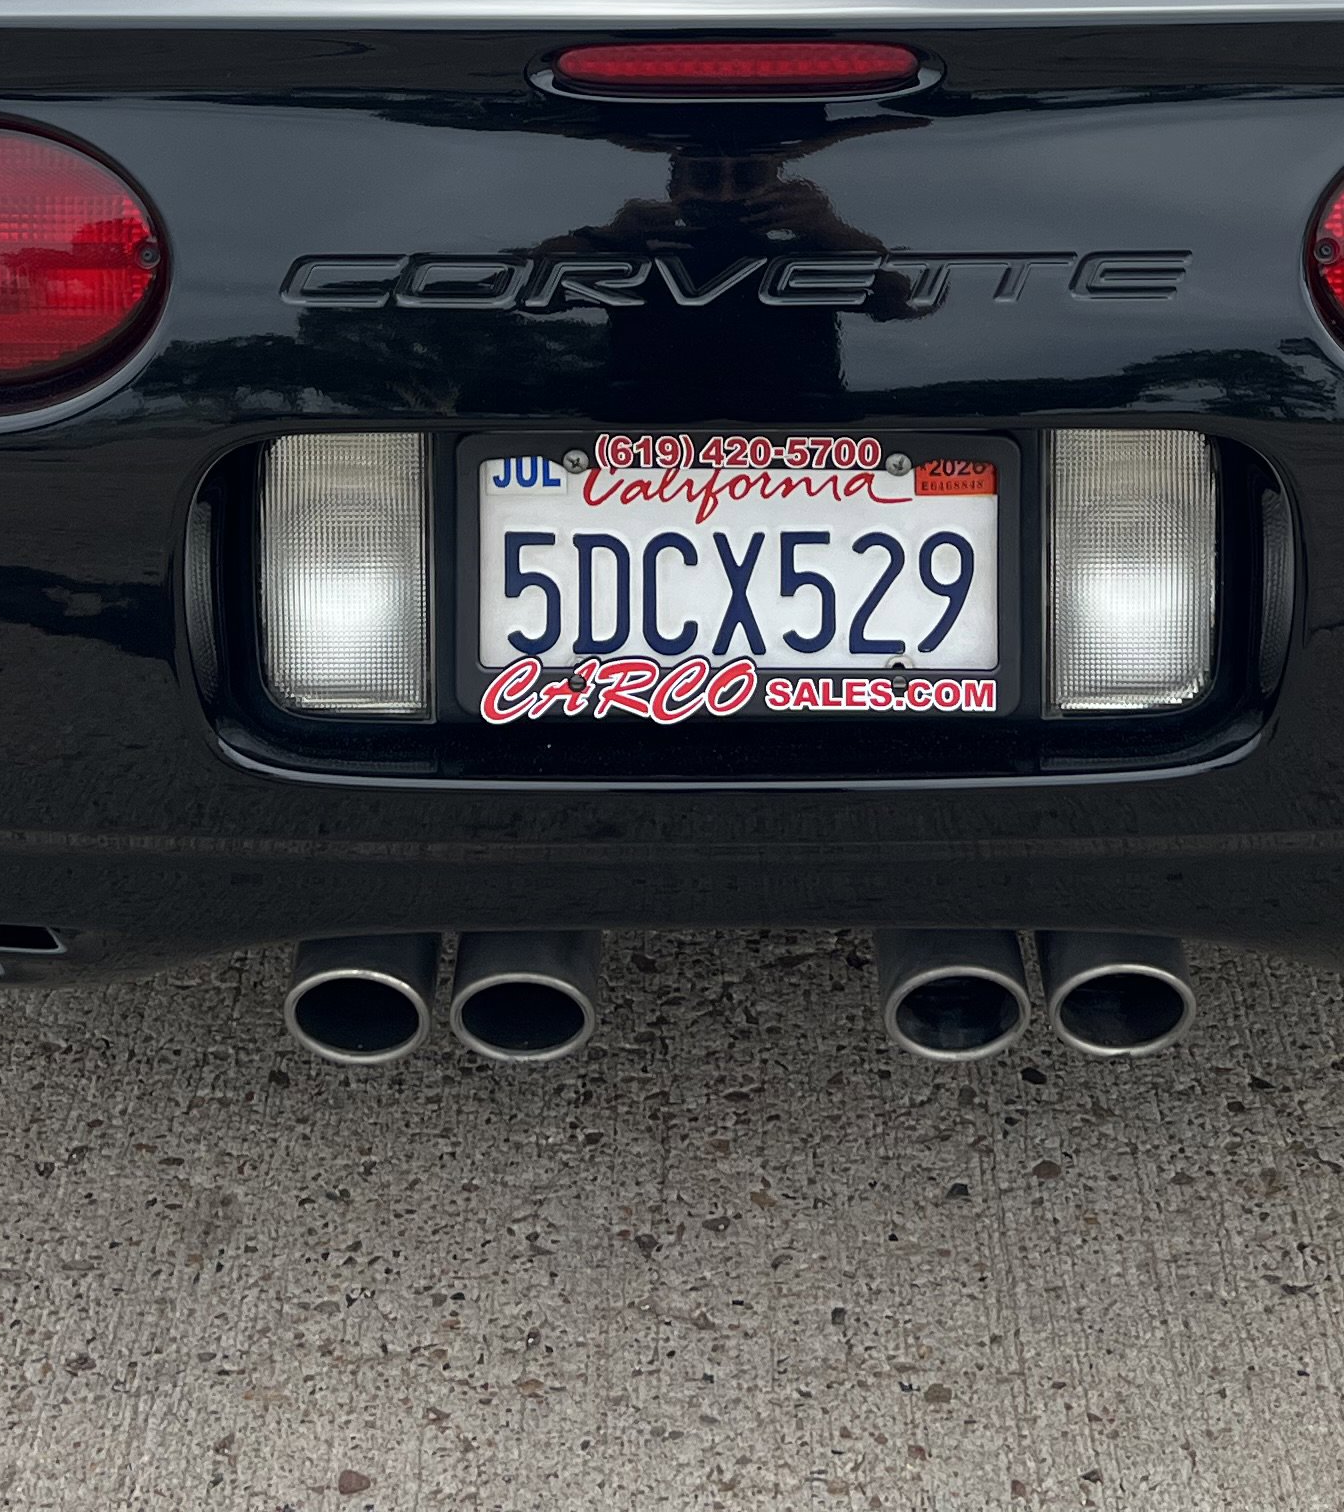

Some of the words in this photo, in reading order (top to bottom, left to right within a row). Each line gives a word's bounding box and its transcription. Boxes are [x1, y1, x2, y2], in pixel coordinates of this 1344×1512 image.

[280, 250, 1193, 308] CORVETTE
[492, 456, 561, 488] JUL
[596, 434, 694, 469] (619)
[700, 436, 881, 469] 420-5700
[583, 467, 913, 524] California
[504, 531, 975, 655] 5DCX529
[480, 656, 757, 724] CARCO
[764, 679, 997, 711] SALES.COM
